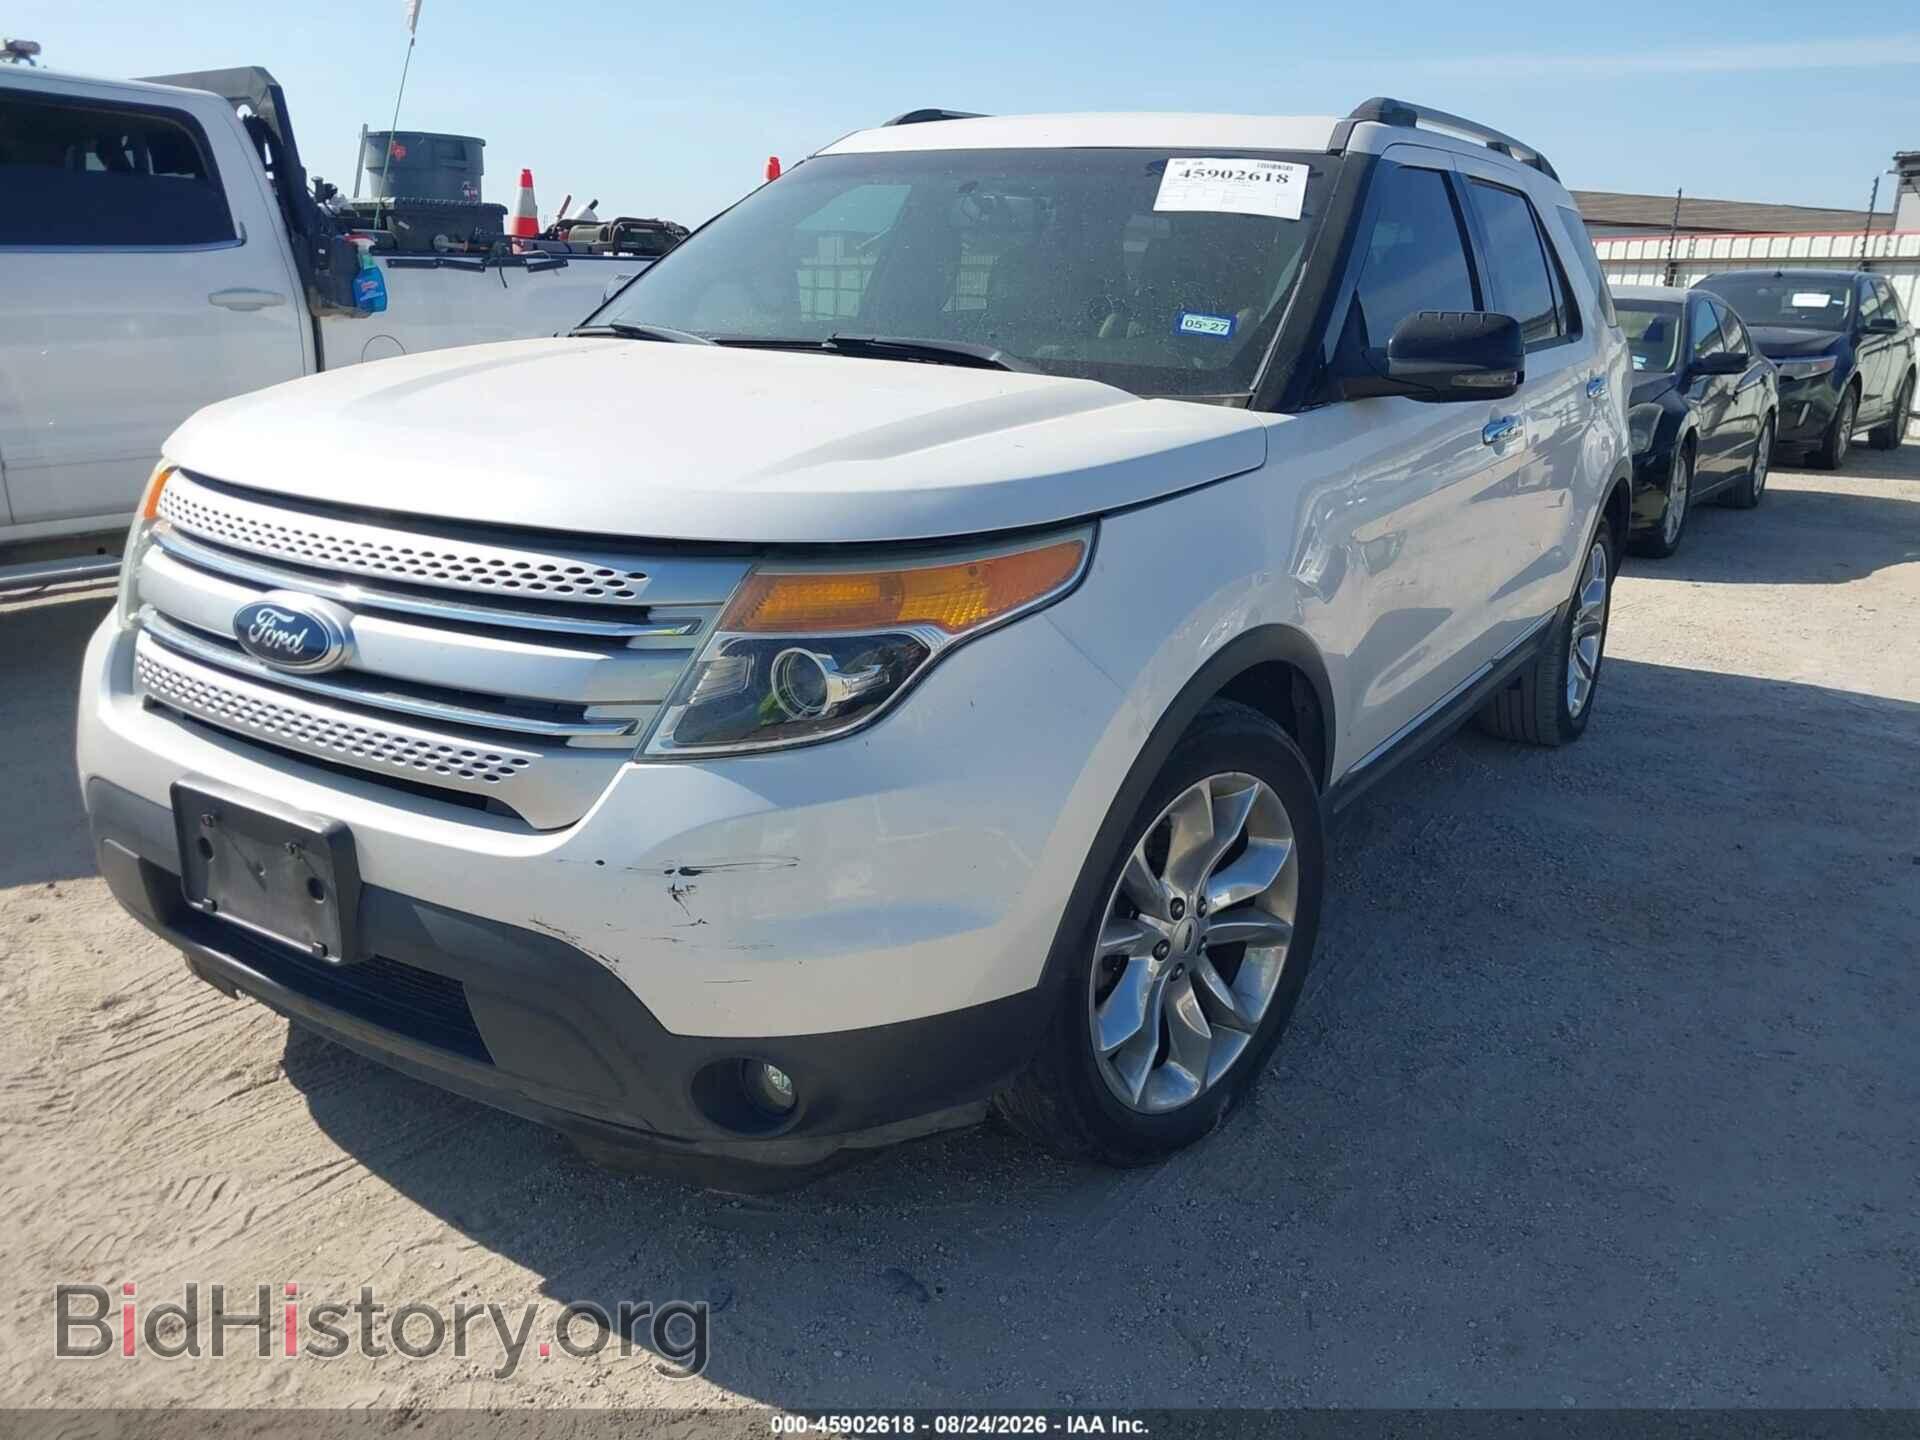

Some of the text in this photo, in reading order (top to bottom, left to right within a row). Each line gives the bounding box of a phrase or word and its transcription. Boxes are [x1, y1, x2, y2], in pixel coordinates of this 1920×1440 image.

[1179, 168, 1289, 184] 45902618
[1184, 319, 1228, 332] 05 27
[247, 607, 309, 655] Ford
